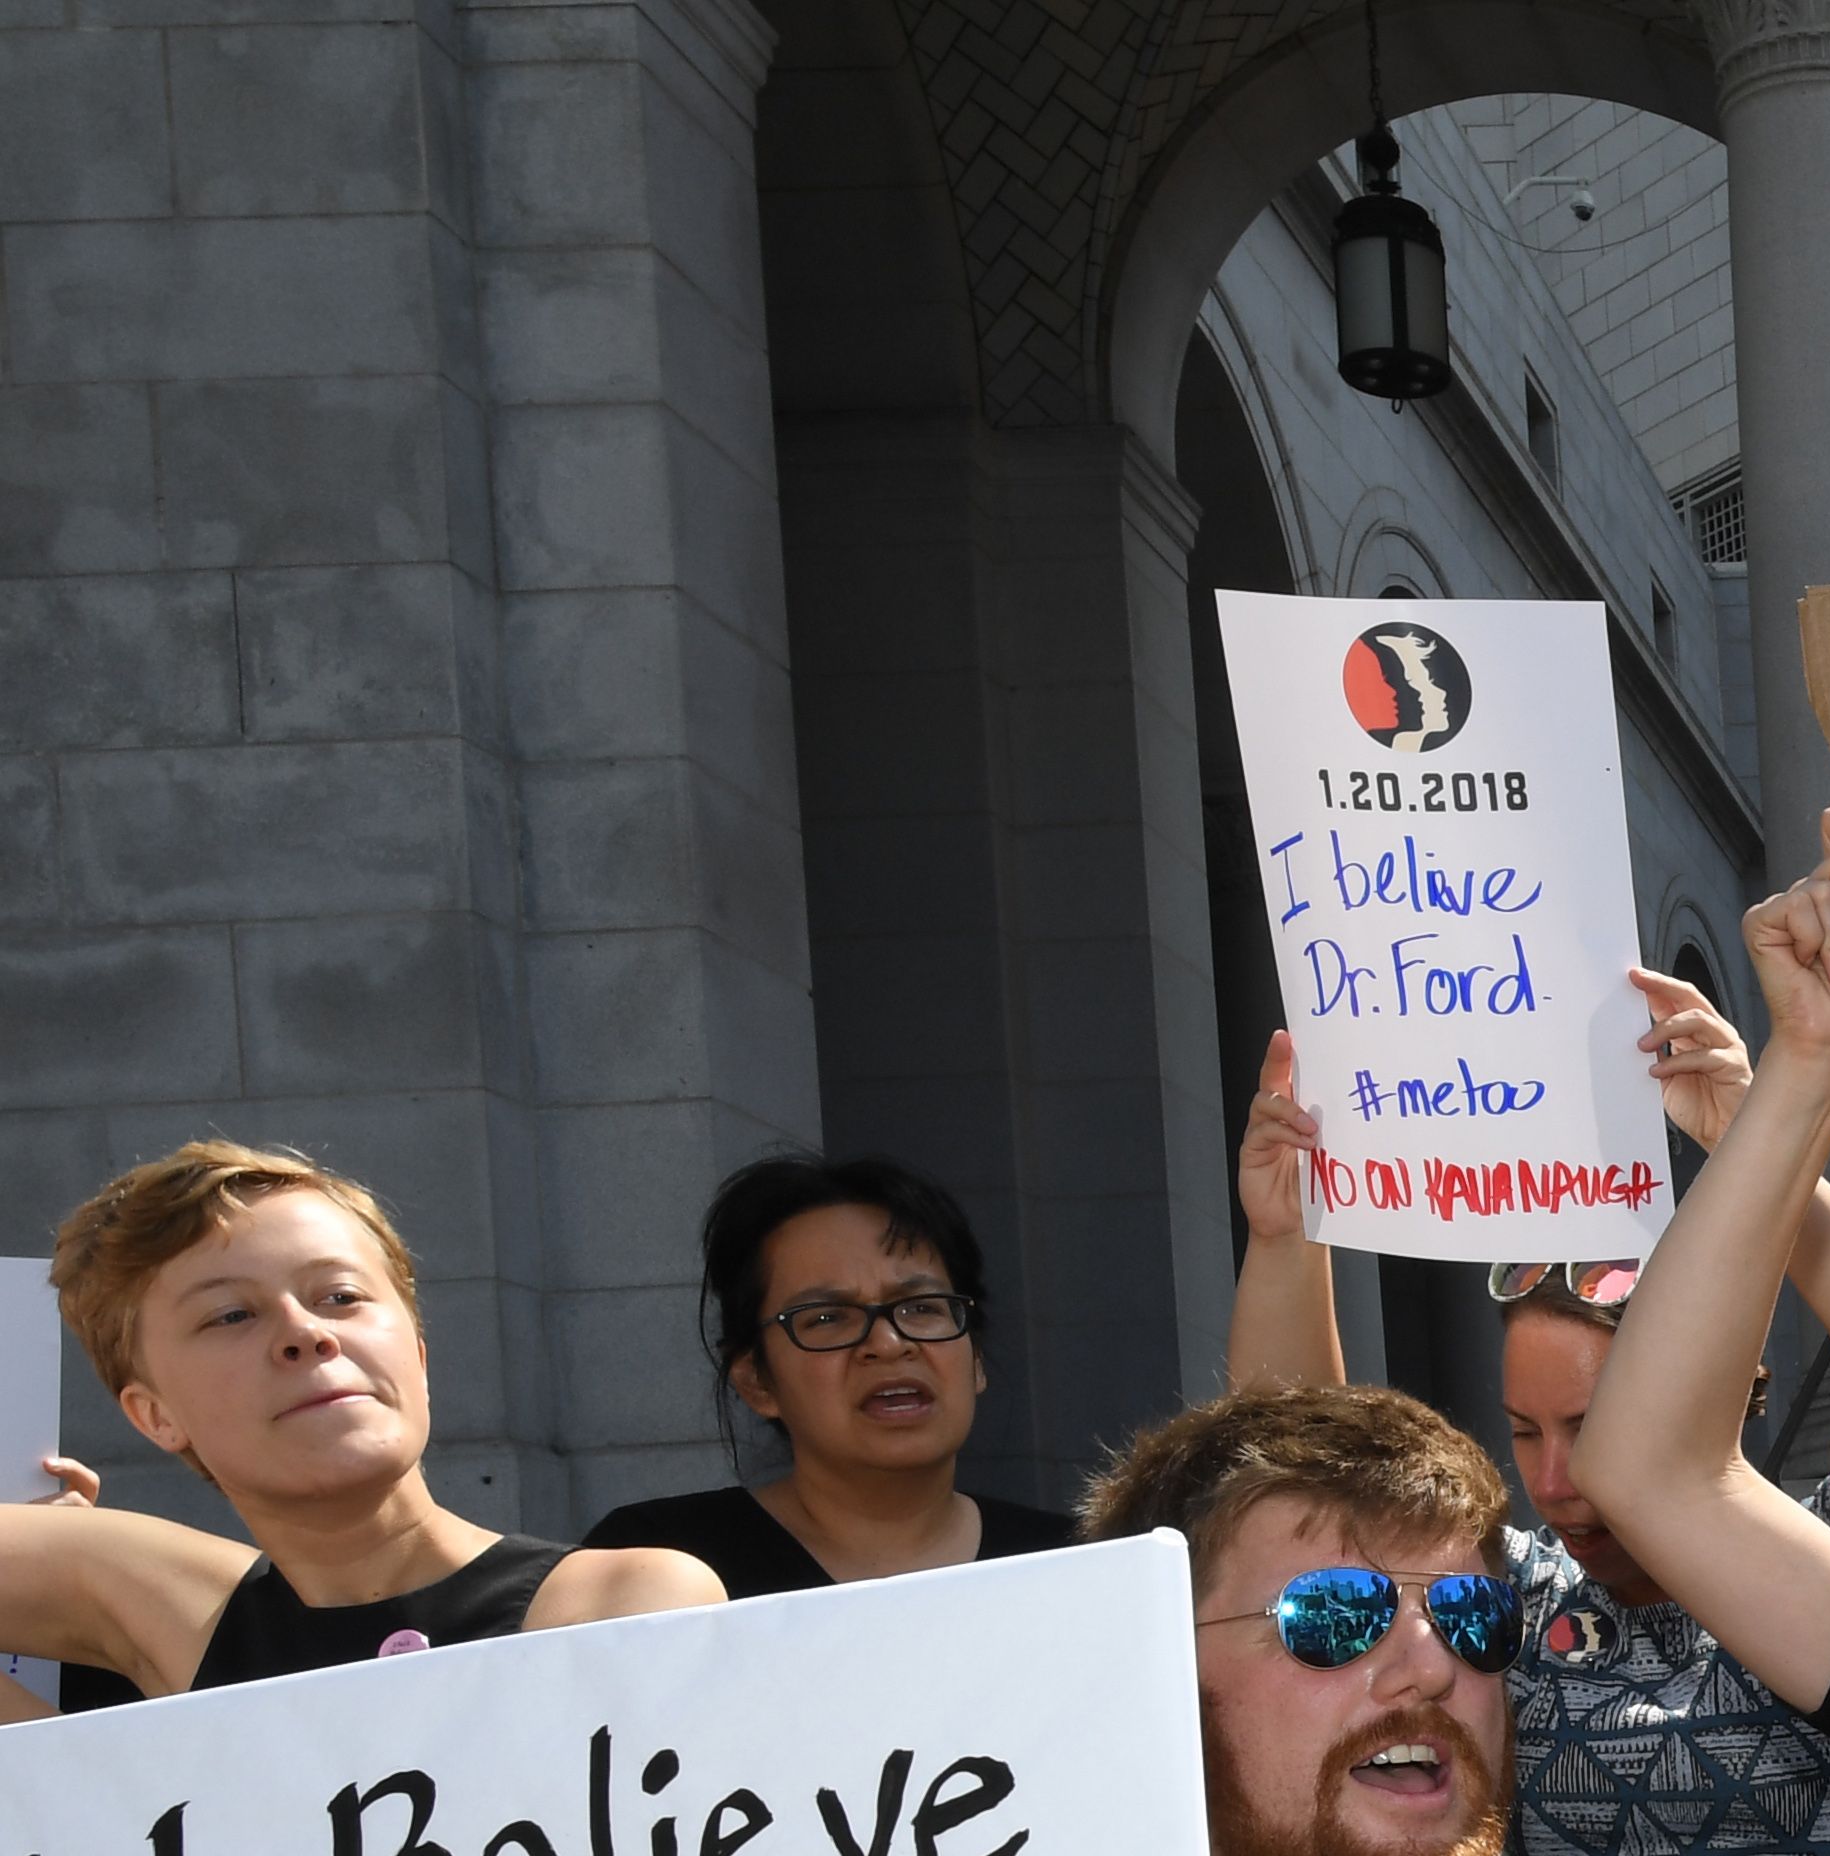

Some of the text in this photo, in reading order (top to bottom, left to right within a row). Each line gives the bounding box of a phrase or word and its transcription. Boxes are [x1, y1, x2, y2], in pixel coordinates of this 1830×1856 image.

[1318, 768, 1529, 812] 1.20.2018
[1271, 832, 1309, 930] I
[1349, 1057, 1546, 1122] #metoo
[1311, 1148, 1664, 1222] NO ON KAVANAUGH
